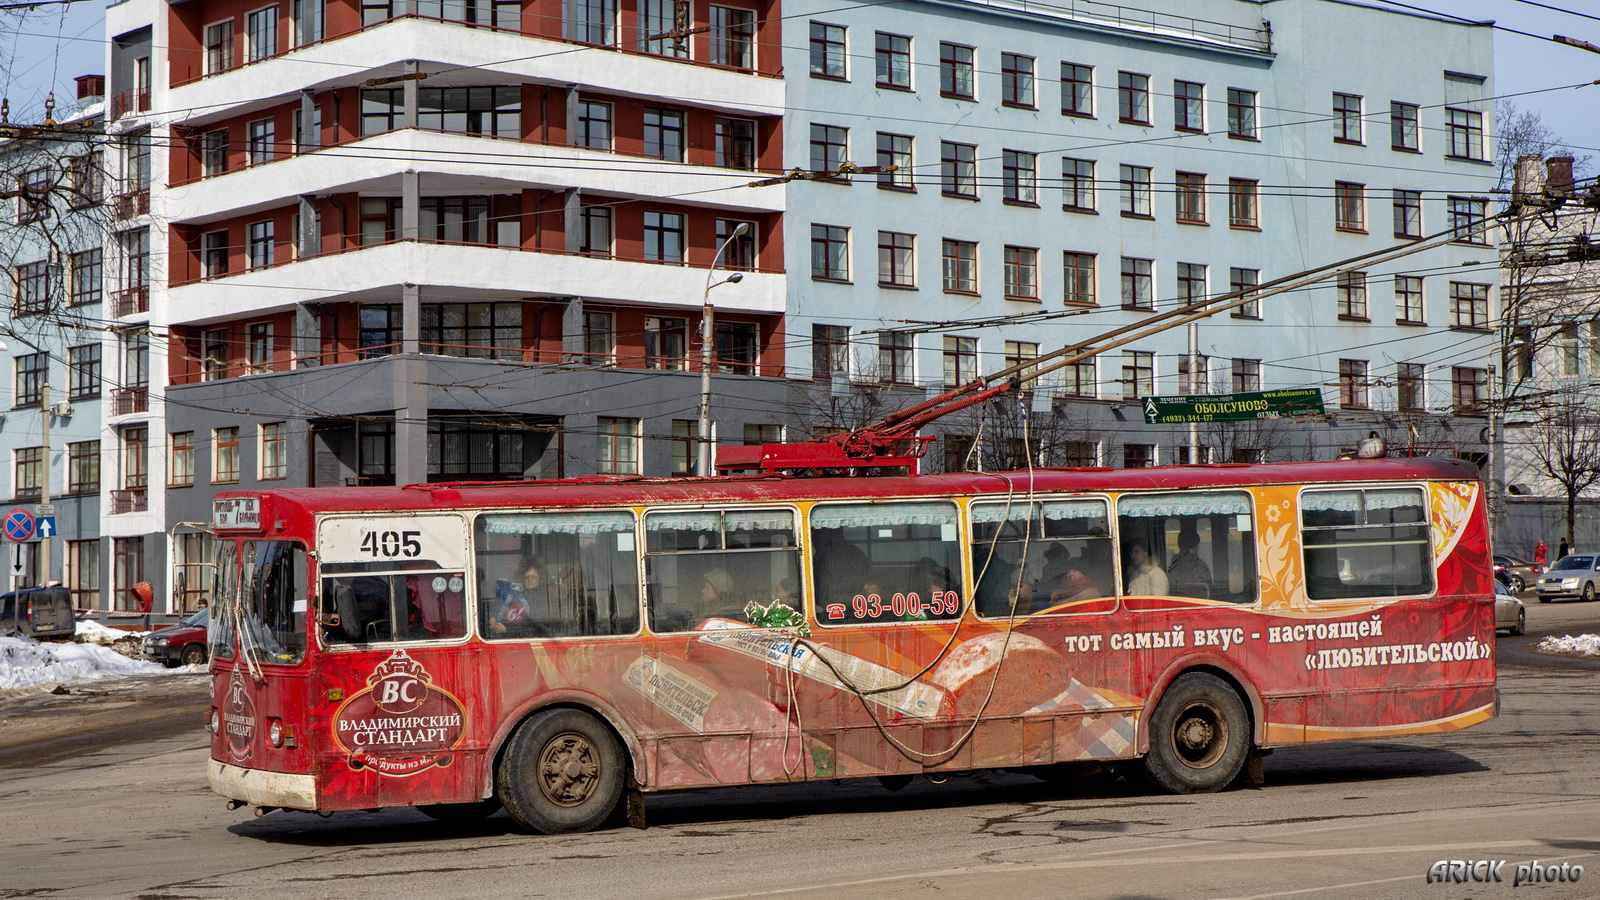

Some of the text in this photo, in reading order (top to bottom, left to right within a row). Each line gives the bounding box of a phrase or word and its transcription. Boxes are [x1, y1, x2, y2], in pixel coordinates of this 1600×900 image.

[1194, 399, 1269, 414] ОБОЛСУНОВО
[1162, 414, 1213, 423] (4932) 344-177
[234, 500, 241, 525] 7
[360, 531, 422, 557] 405
[852, 590, 959, 619] 93-00-59
[1065, 634, 1103, 653] тот
[1110, 625, 1185, 651] самый
[1193, 627, 1244, 652] вкус
[1268, 614, 1383, 643] настоящей
[1304, 636, 1491, 670] «ЛЮБИТЕЛЬСКОЙ»
[233, 686, 243, 705] ВС
[380, 680, 418, 704] ВС
[649, 673, 708, 717] ЛЮБИТЕЛЬСК
[226, 722, 252, 738] СТАНДАРТ
[339, 713, 461, 734] ВЛАДИМИРСКИЙ
[353, 728, 447, 746] СТАНДАРТ
[408, 760, 419, 768] из
